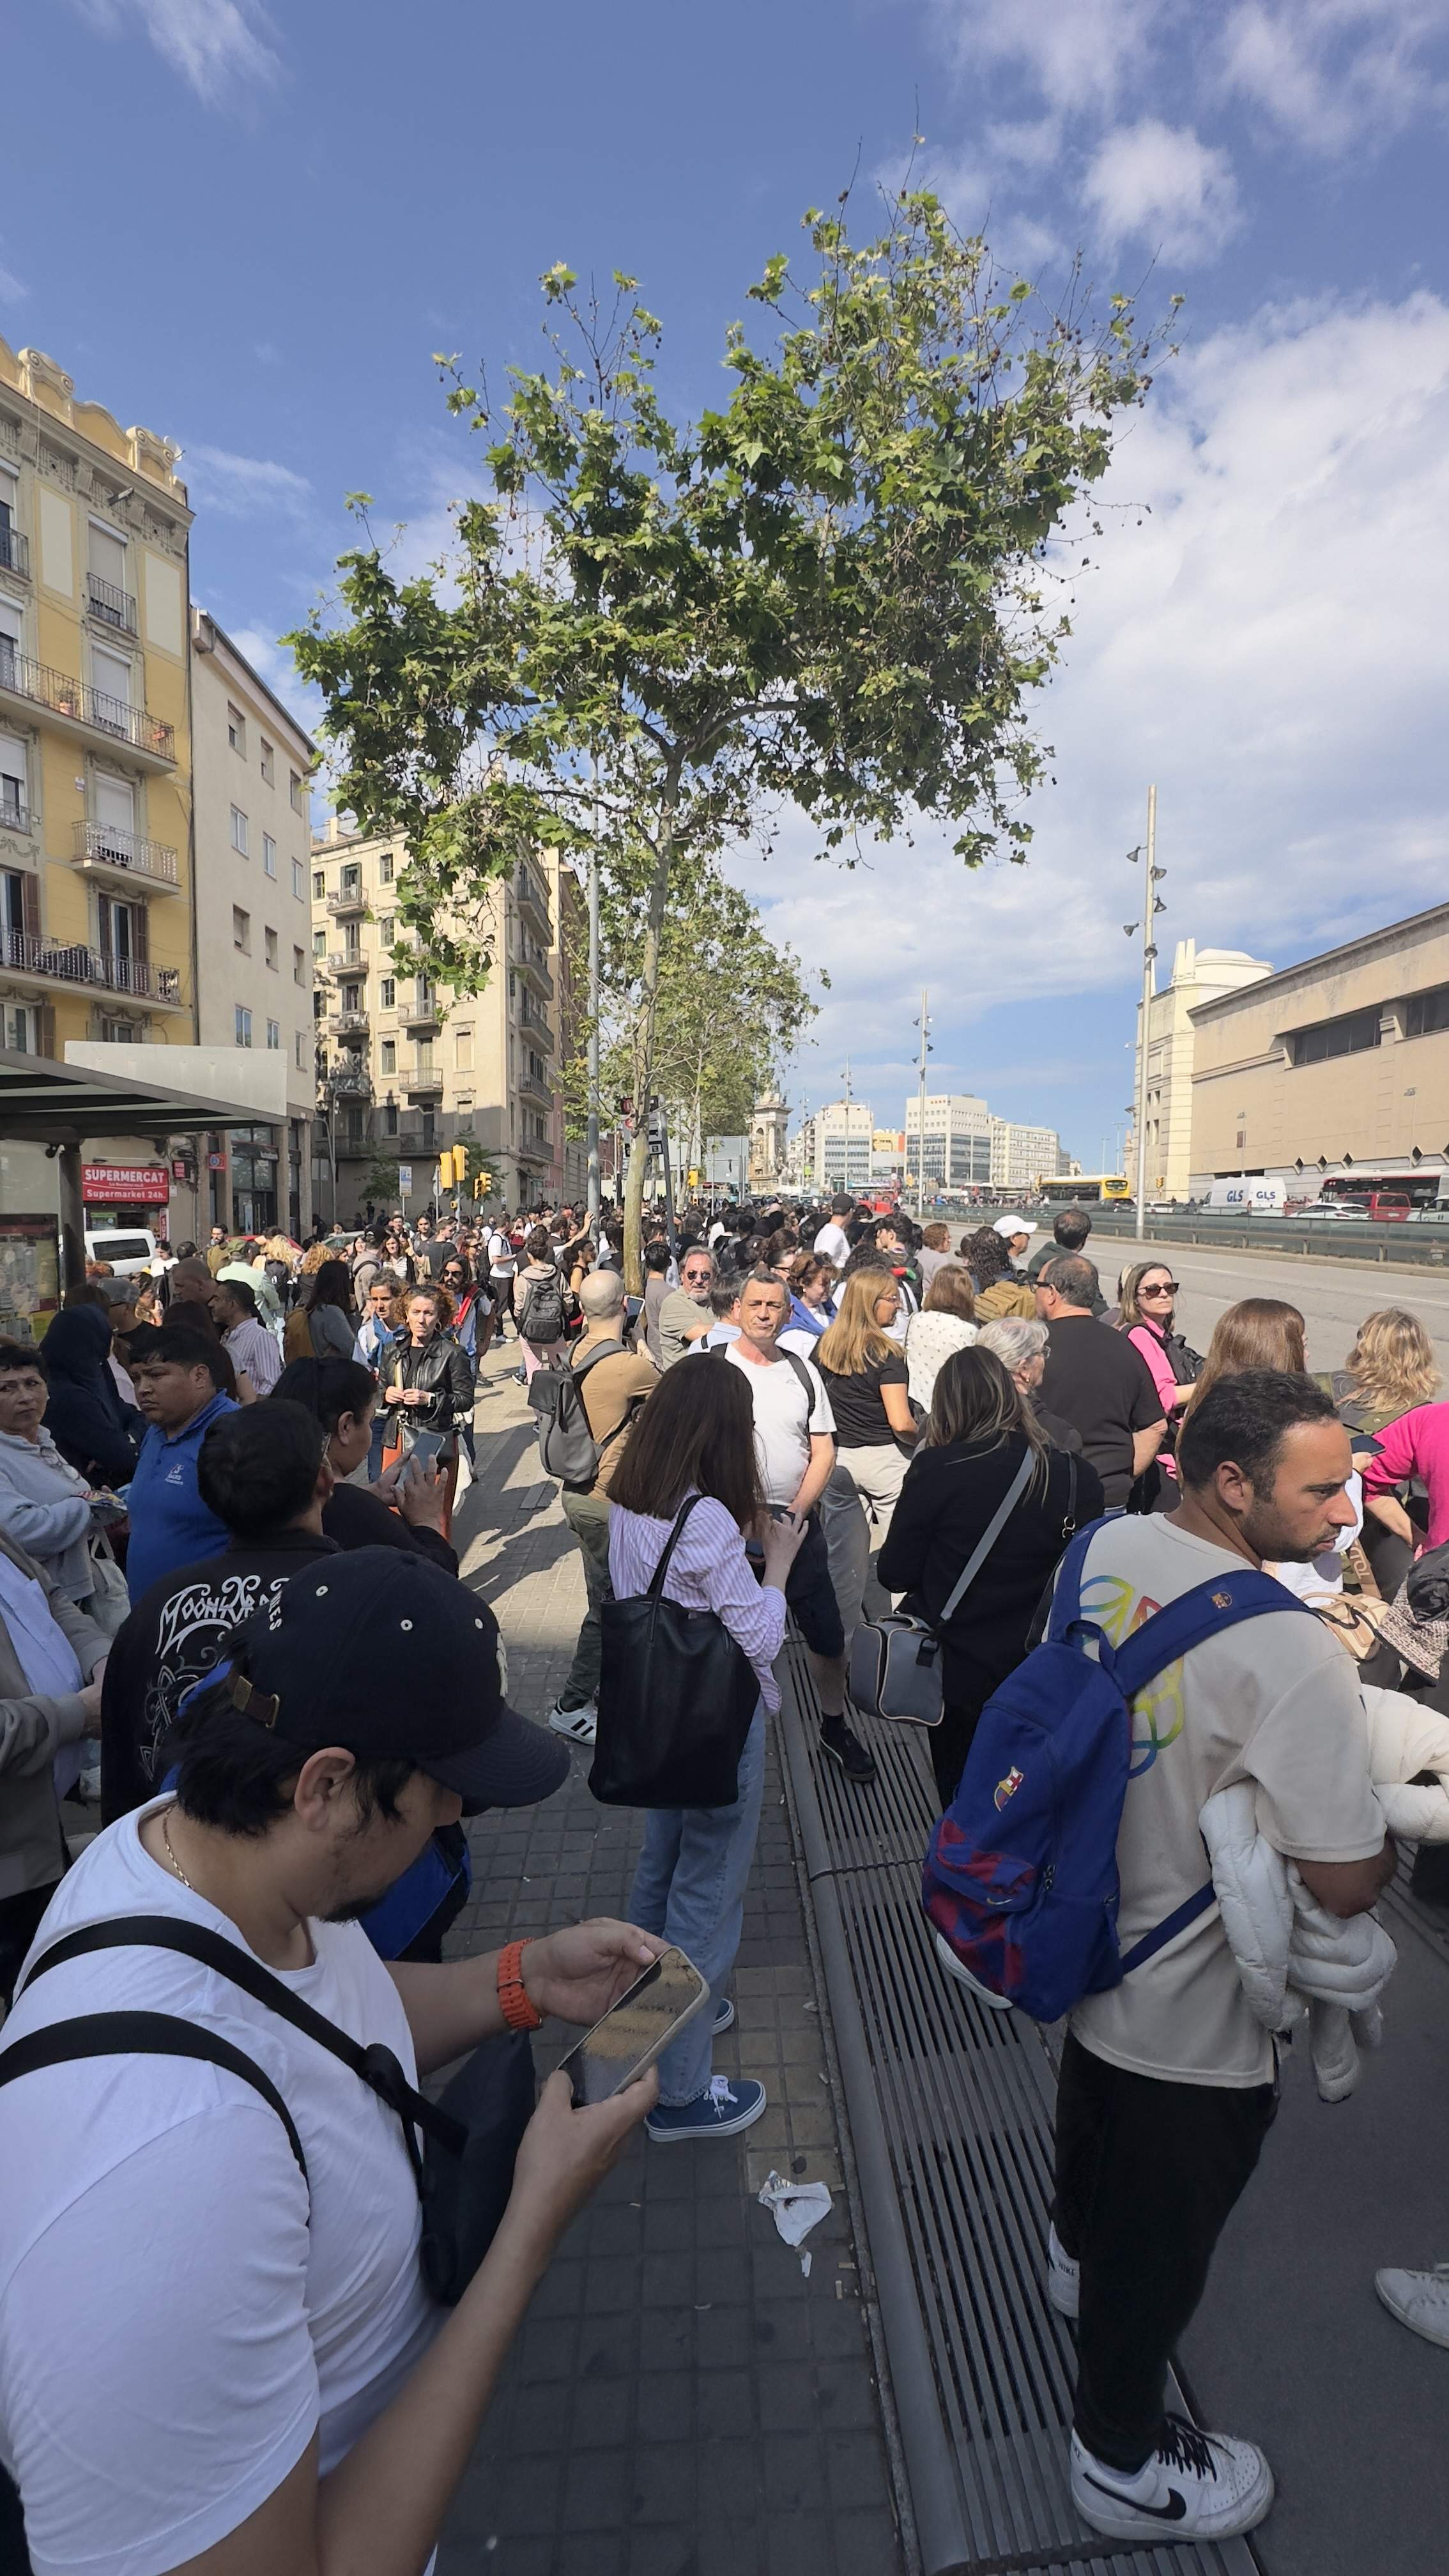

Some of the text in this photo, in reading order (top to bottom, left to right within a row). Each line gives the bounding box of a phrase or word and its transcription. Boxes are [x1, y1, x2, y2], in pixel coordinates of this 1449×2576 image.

[85, 1169, 164, 1183] SUPERMERCAT
[87, 1188, 166, 1199] Supermarket 24h.
[1227, 1190, 1244, 1202] GLS
[1256, 1191, 1276, 1200] GLS
